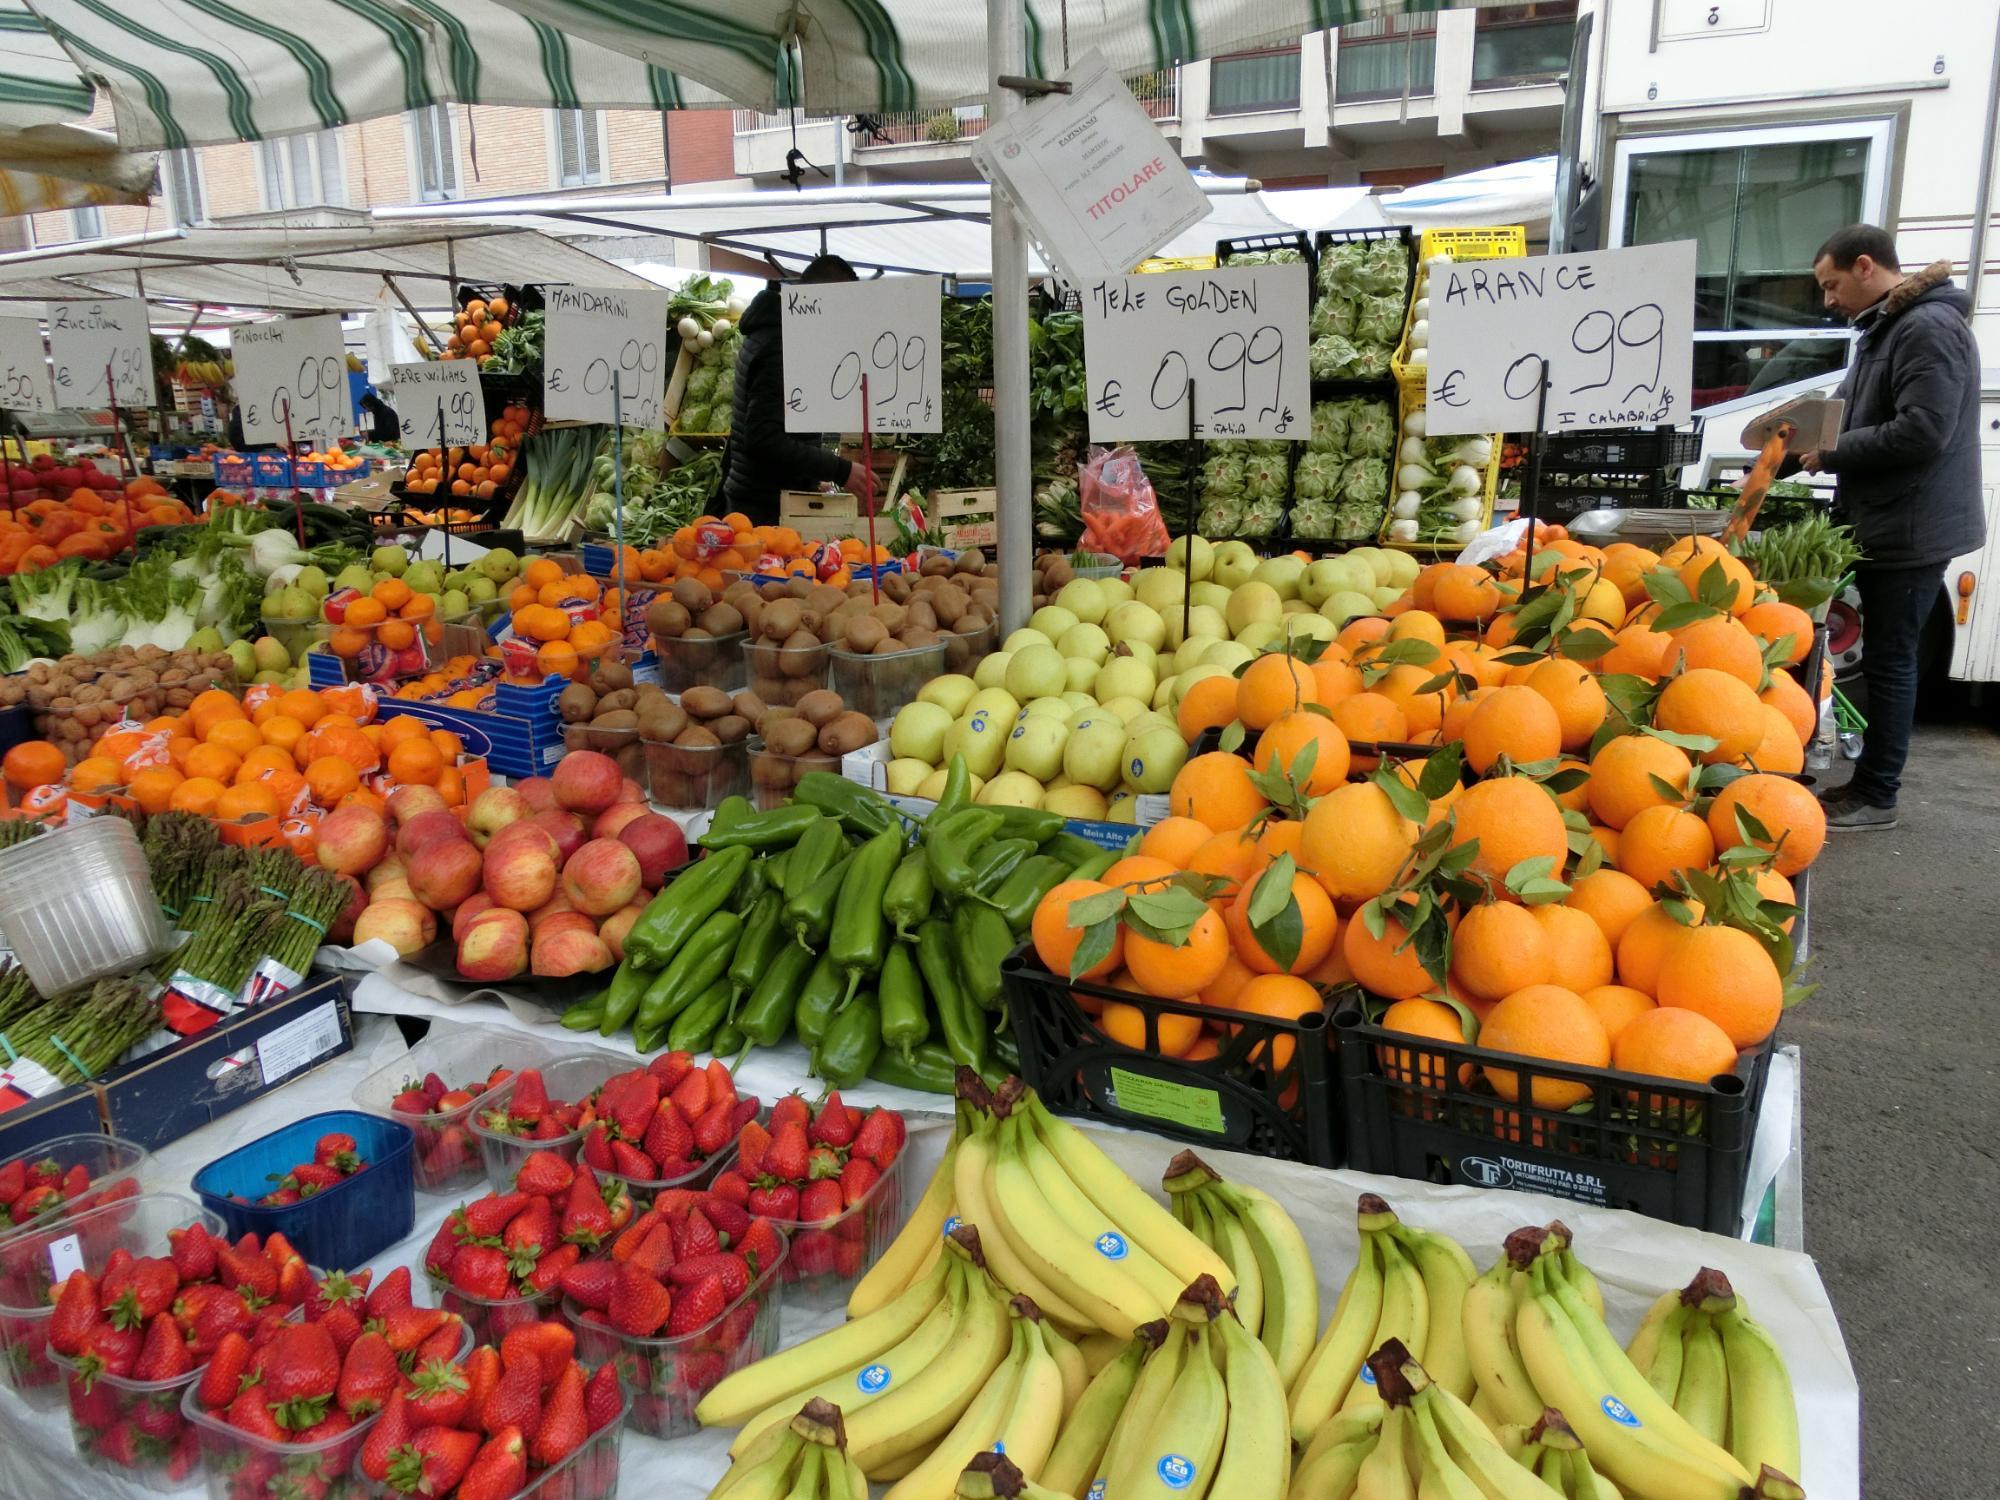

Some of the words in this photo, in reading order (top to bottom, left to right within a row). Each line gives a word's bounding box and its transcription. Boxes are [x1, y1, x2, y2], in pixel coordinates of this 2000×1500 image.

[1058, 115, 1098, 148] PAPINIANO
[1086, 157, 1167, 222] TITOLARE
[1445, 265, 1595, 306] ARANCE
[788, 292, 822, 316] Kiwi
[1093, 278, 1146, 319] MELE
[1166, 278, 1258, 314] GOLDEN
[57, 366, 74, 387] €
[392, 367, 421, 385] PERE
[547, 368, 569, 392] €
[1432, 369, 1471, 407] €
[247, 404, 262, 426] €
[272, 356, 341, 429] 0.99
[786, 387, 808, 413] €
[1095, 379, 1125, 418] €
[400, 418, 415, 435] €
[1106, 831, 1124, 841] Alto
[1500, 1156, 1573, 1183] TORTIFRUTTA
[1575, 1173, 1606, 1189] S.R.L.
[866, 1369, 884, 1383] SCB
[1165, 1461, 1183, 1475] SCB
[1088, 1490, 1105, 1500] SC
